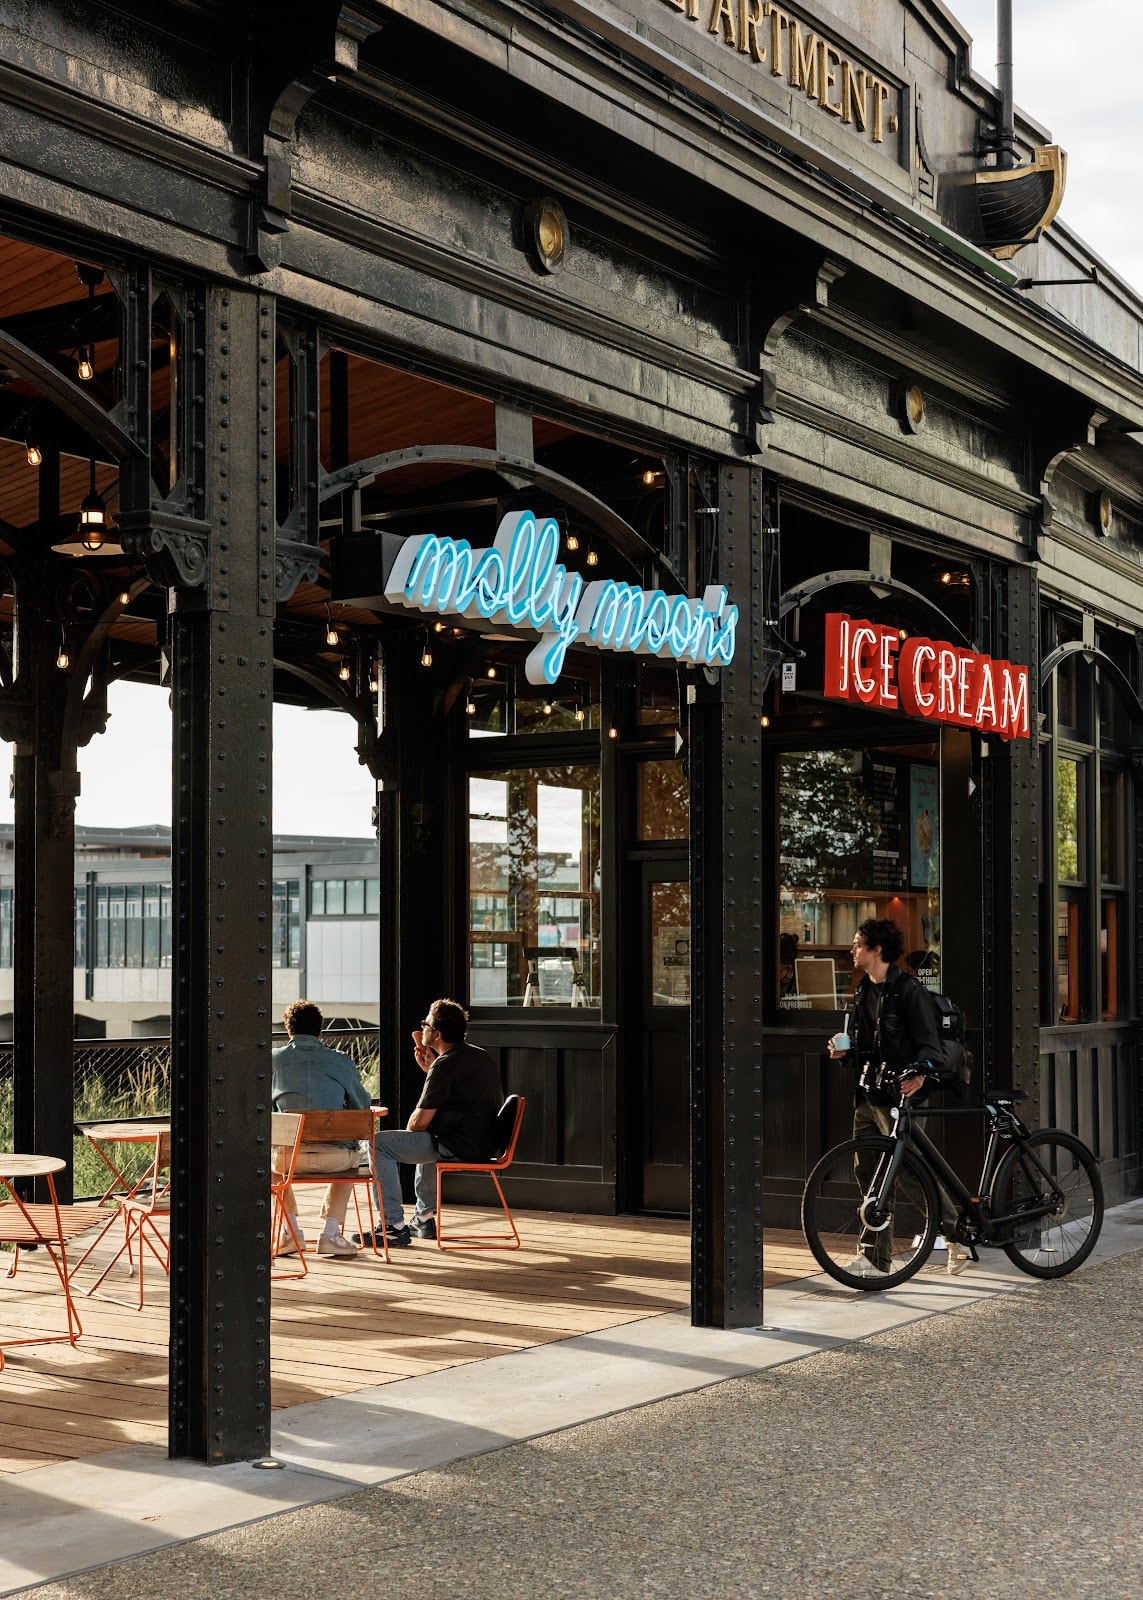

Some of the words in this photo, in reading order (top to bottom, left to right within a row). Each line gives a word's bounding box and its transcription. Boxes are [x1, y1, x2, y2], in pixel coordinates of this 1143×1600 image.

[664, 0, 890, 143] ARTMENT
[400, 509, 583, 684] molly
[586, 577, 739, 666] moon's
[832, 616, 898, 706] ICE
[907, 640, 1030, 737] CREAM
[917, 968, 933, 976] OPEN
